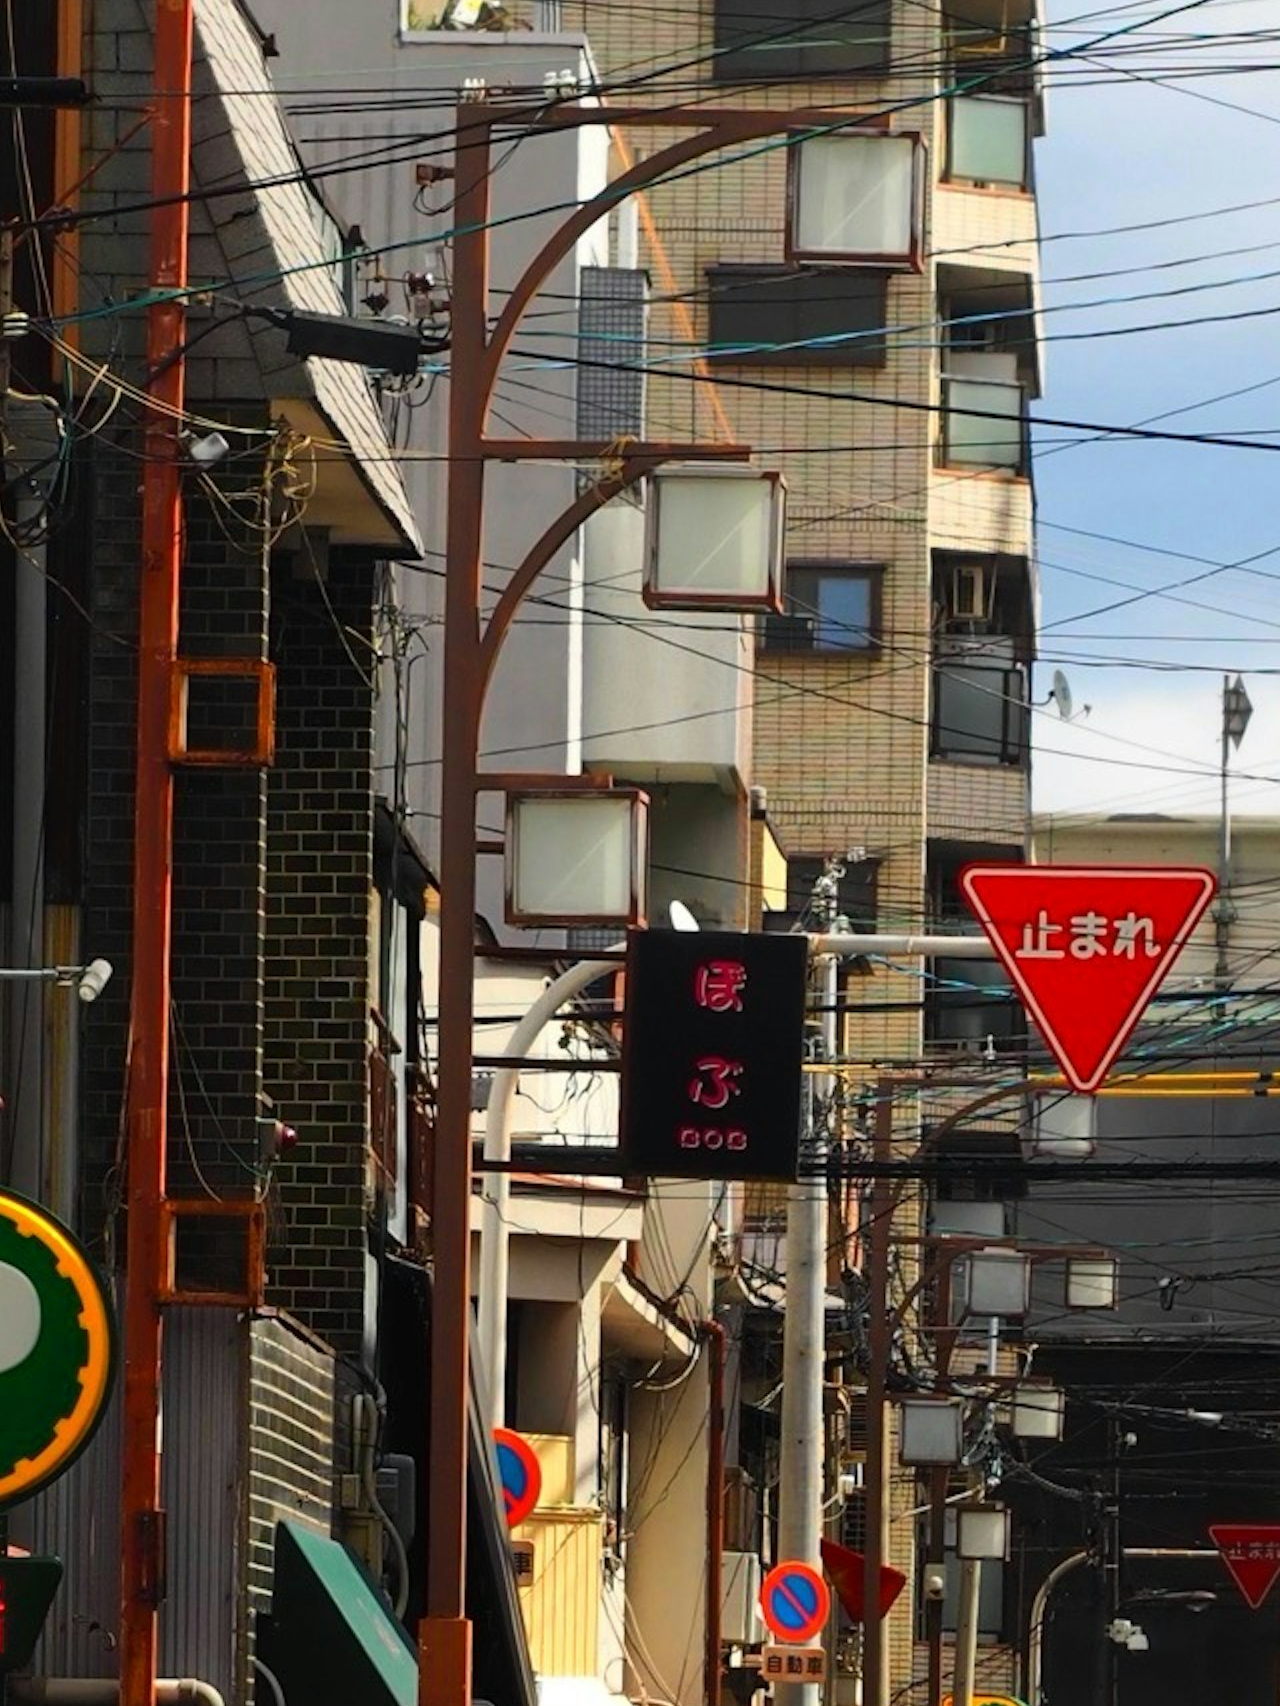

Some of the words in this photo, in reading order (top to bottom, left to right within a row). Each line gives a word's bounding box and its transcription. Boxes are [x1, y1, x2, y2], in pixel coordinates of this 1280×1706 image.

[1014, 911, 1161, 961] 止まれ
[767, 1654, 823, 1676] 自動車
